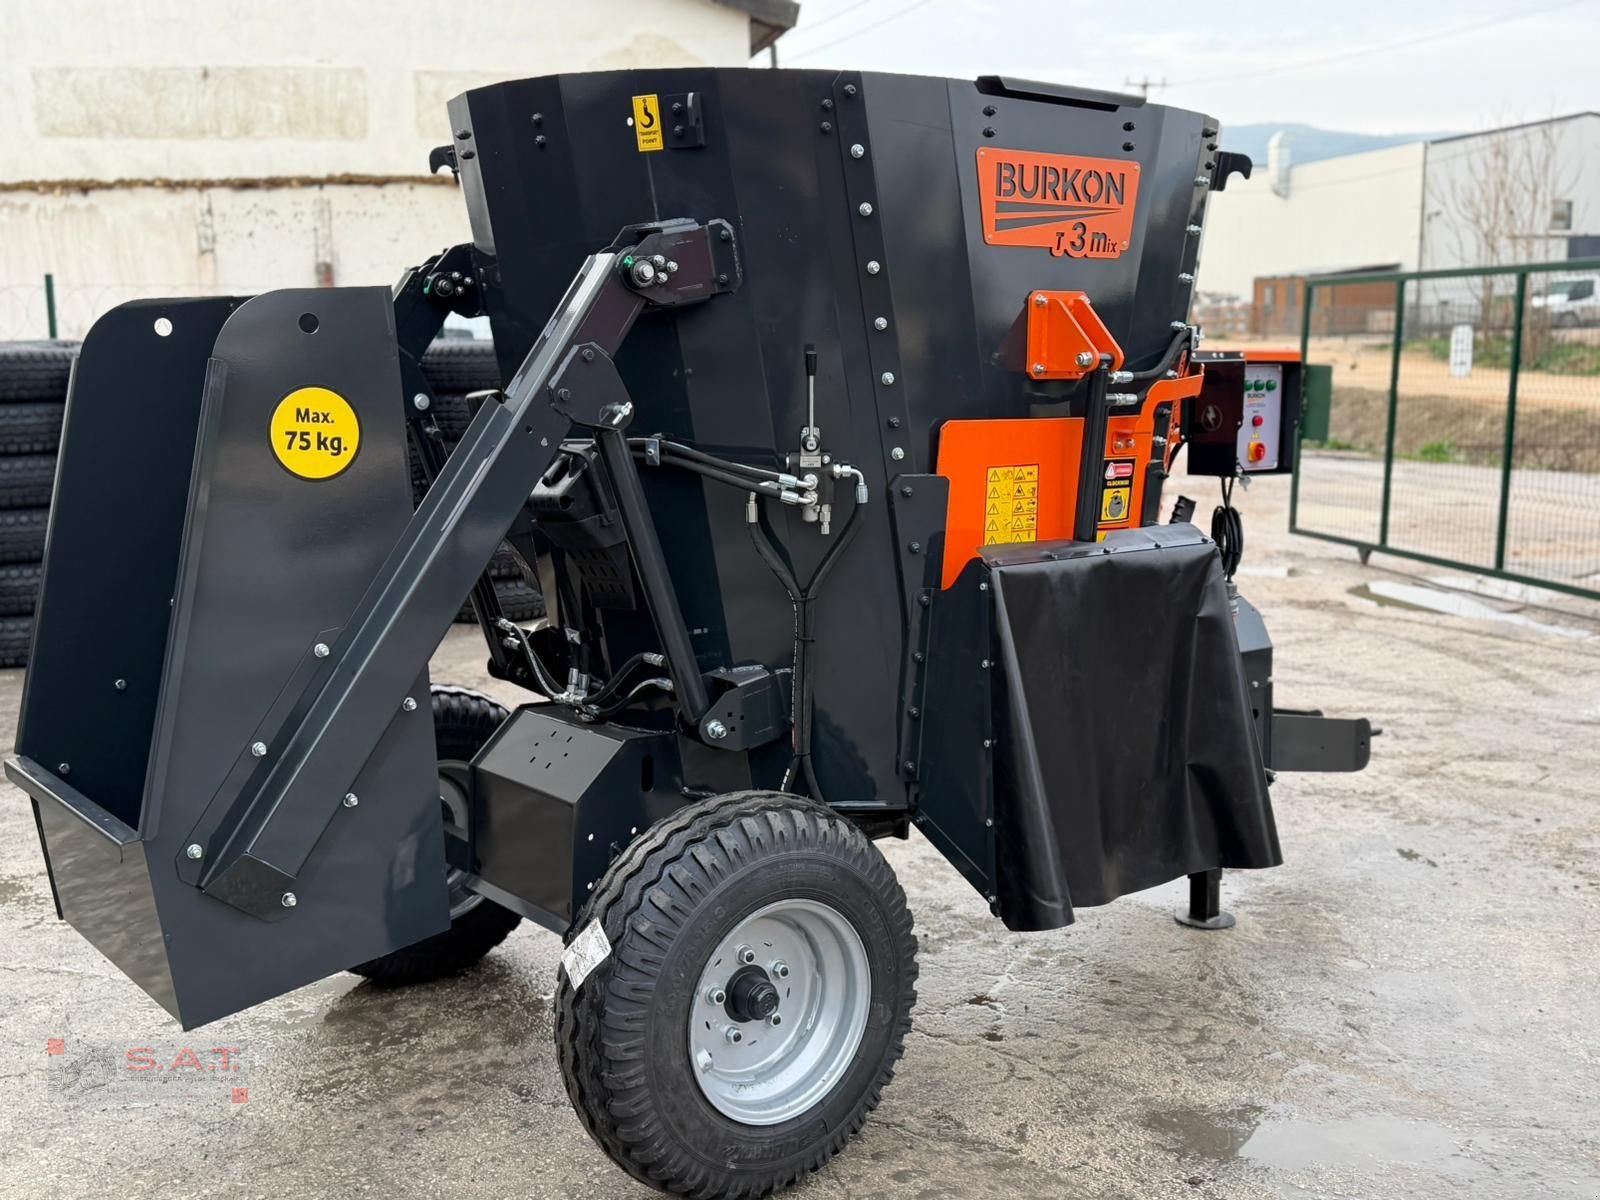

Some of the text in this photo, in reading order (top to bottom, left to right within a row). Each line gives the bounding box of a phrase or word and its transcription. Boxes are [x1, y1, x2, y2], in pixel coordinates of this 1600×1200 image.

[996, 162, 1125, 205] BURKON
[1055, 232, 1065, 250] T
[1069, 222, 1087, 251] 3
[296, 408, 334, 423] Max.
[285, 431, 348, 456] 75 kg.
